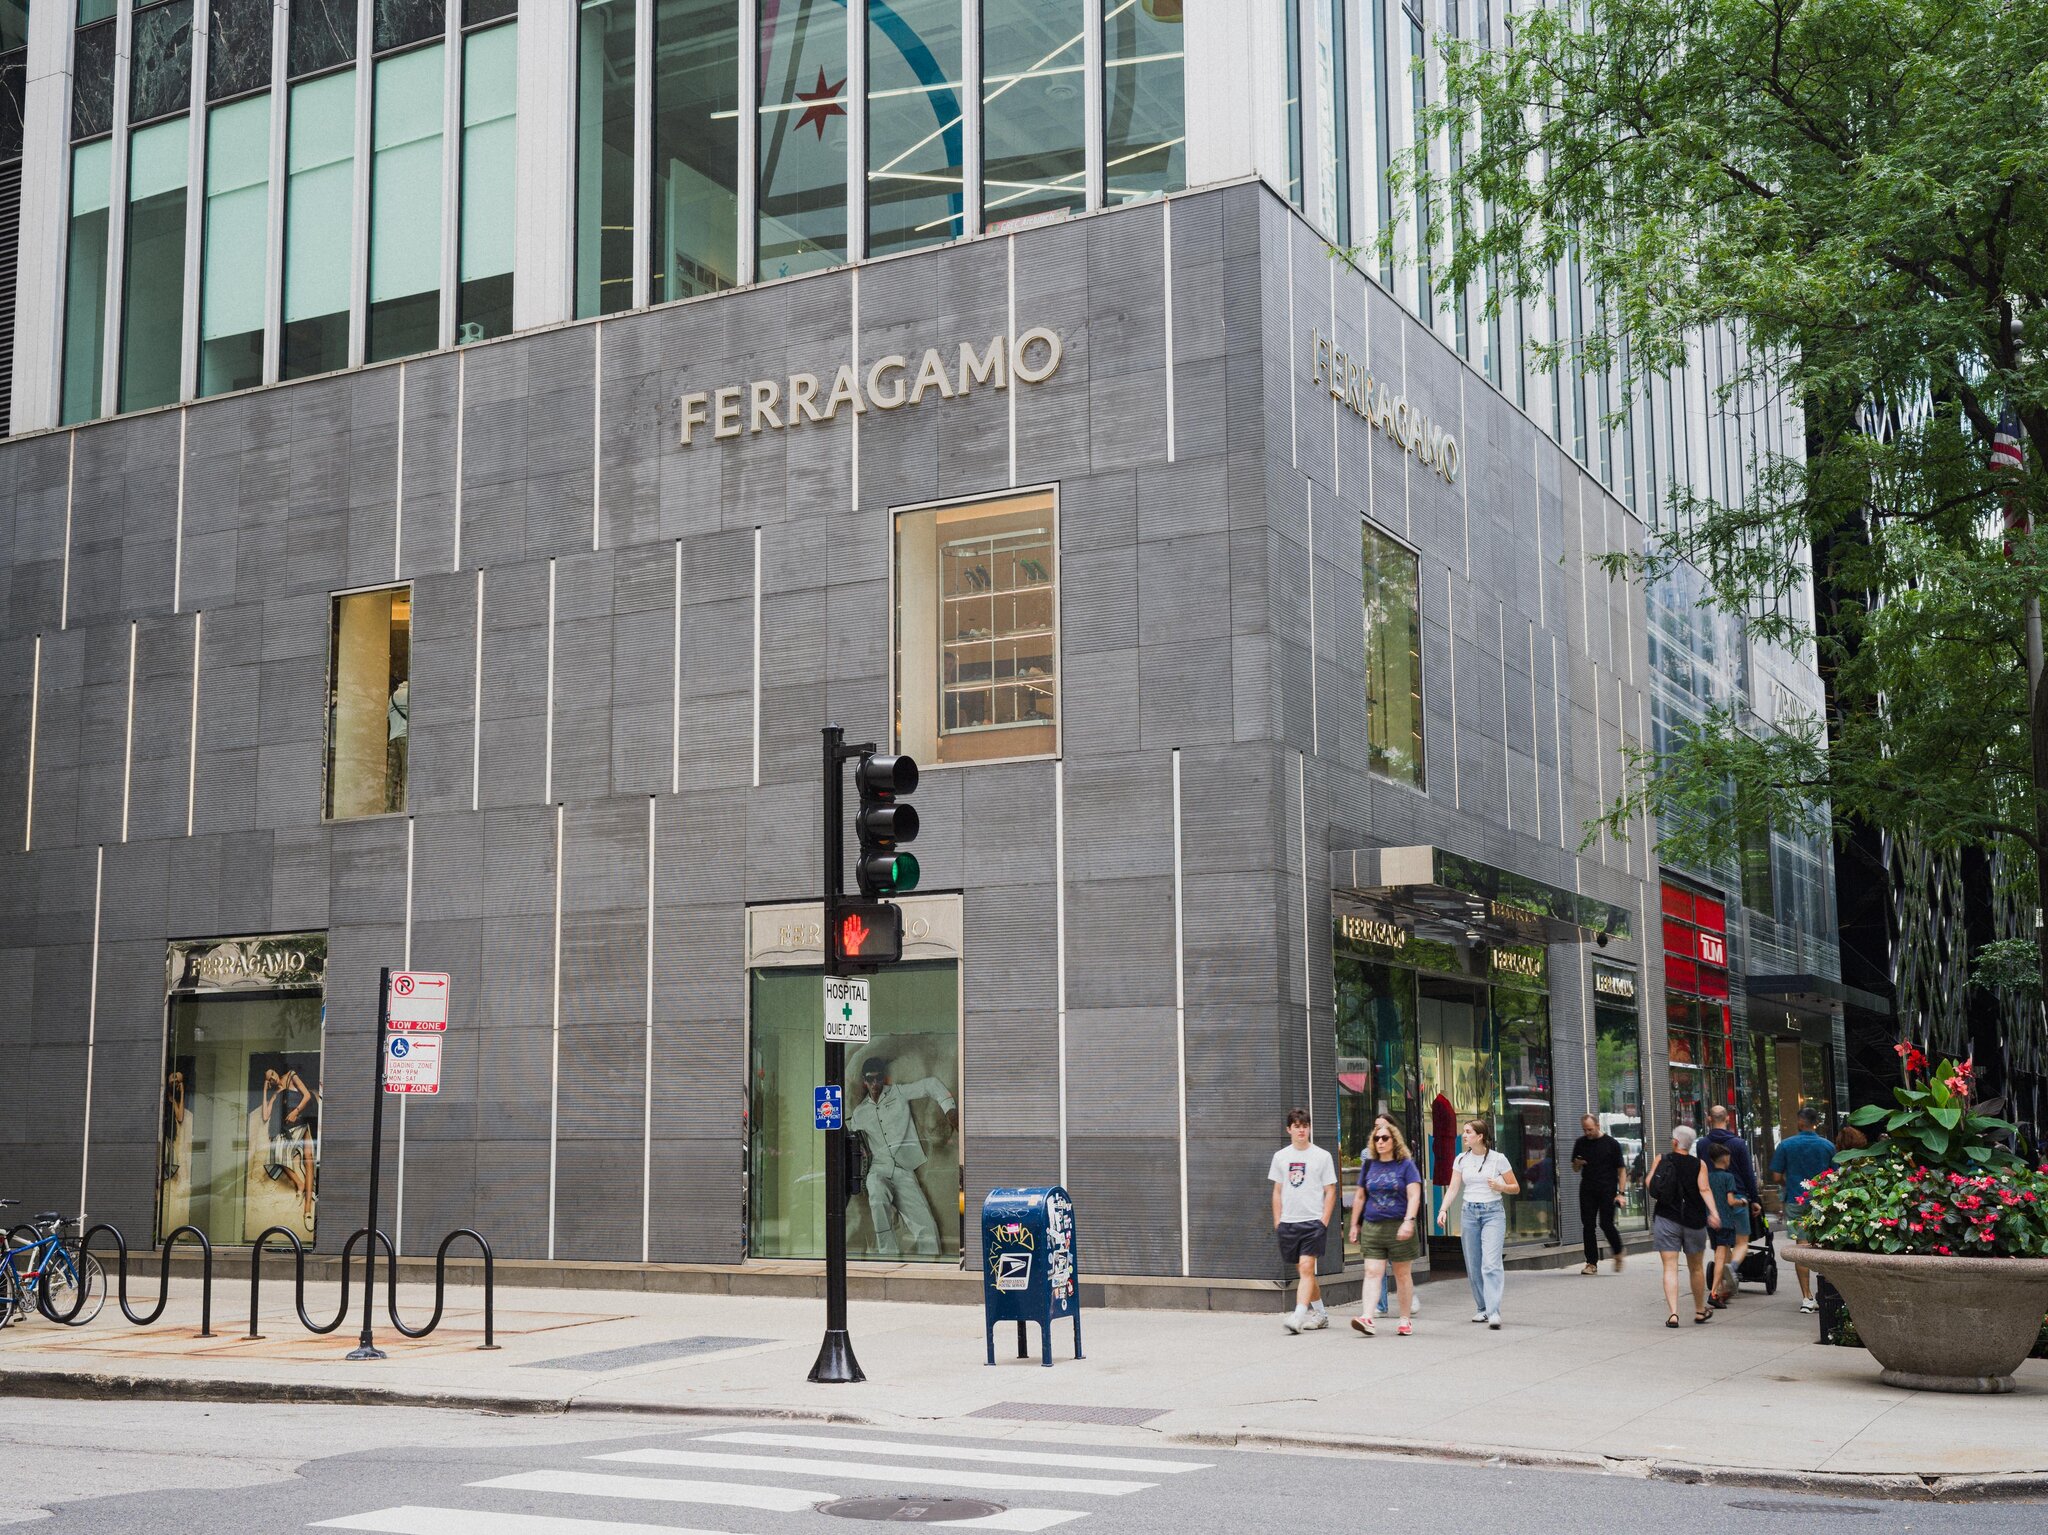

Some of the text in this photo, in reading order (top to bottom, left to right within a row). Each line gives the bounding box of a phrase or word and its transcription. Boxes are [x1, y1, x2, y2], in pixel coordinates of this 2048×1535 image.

[679, 326, 1063, 445] FERRAGAMO
[1312, 327, 1460, 484] FERRAGAMO
[1341, 914, 1406, 949] FERRAGAMO
[191, 951, 306, 977] FERRAGAMO
[826, 983, 868, 1002] HOSPITAL
[392, 1021, 441, 1030] TOW ZONE
[827, 1023, 868, 1037] QUIET ZONE
[389, 1061, 433, 1070] LOADING ZONE
[388, 1084, 434, 1093] TOW ZONE
